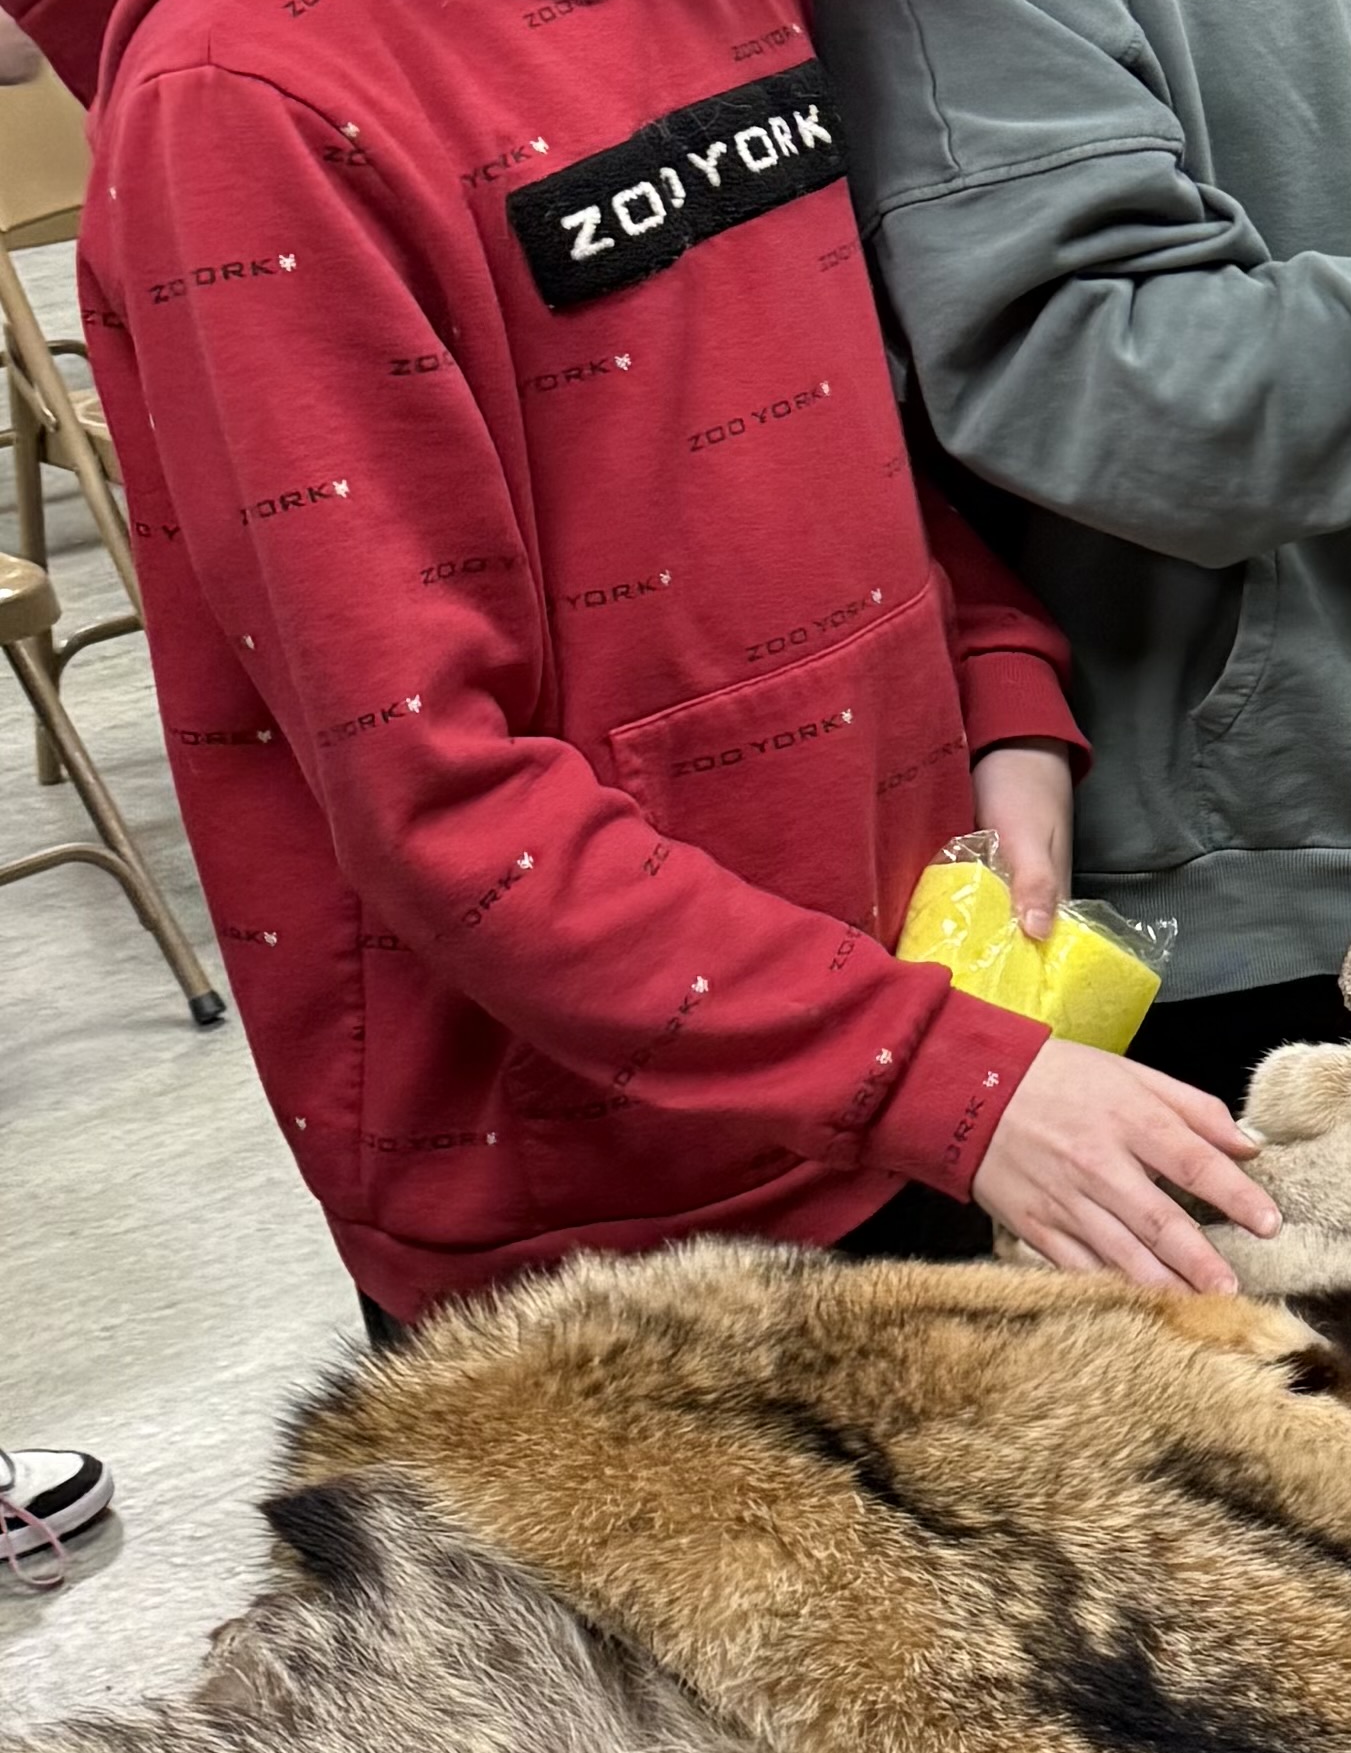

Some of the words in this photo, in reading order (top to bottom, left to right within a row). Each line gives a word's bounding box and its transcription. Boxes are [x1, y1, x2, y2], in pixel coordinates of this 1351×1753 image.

[687, 104, 832, 187] YORK
[687, 417, 746, 452] ZOO
[420, 557, 488, 585] ZOO
[565, 576, 656, 610] YORK
[744, 626, 808, 663] ZOO
[748, 715, 839, 755] YORK
